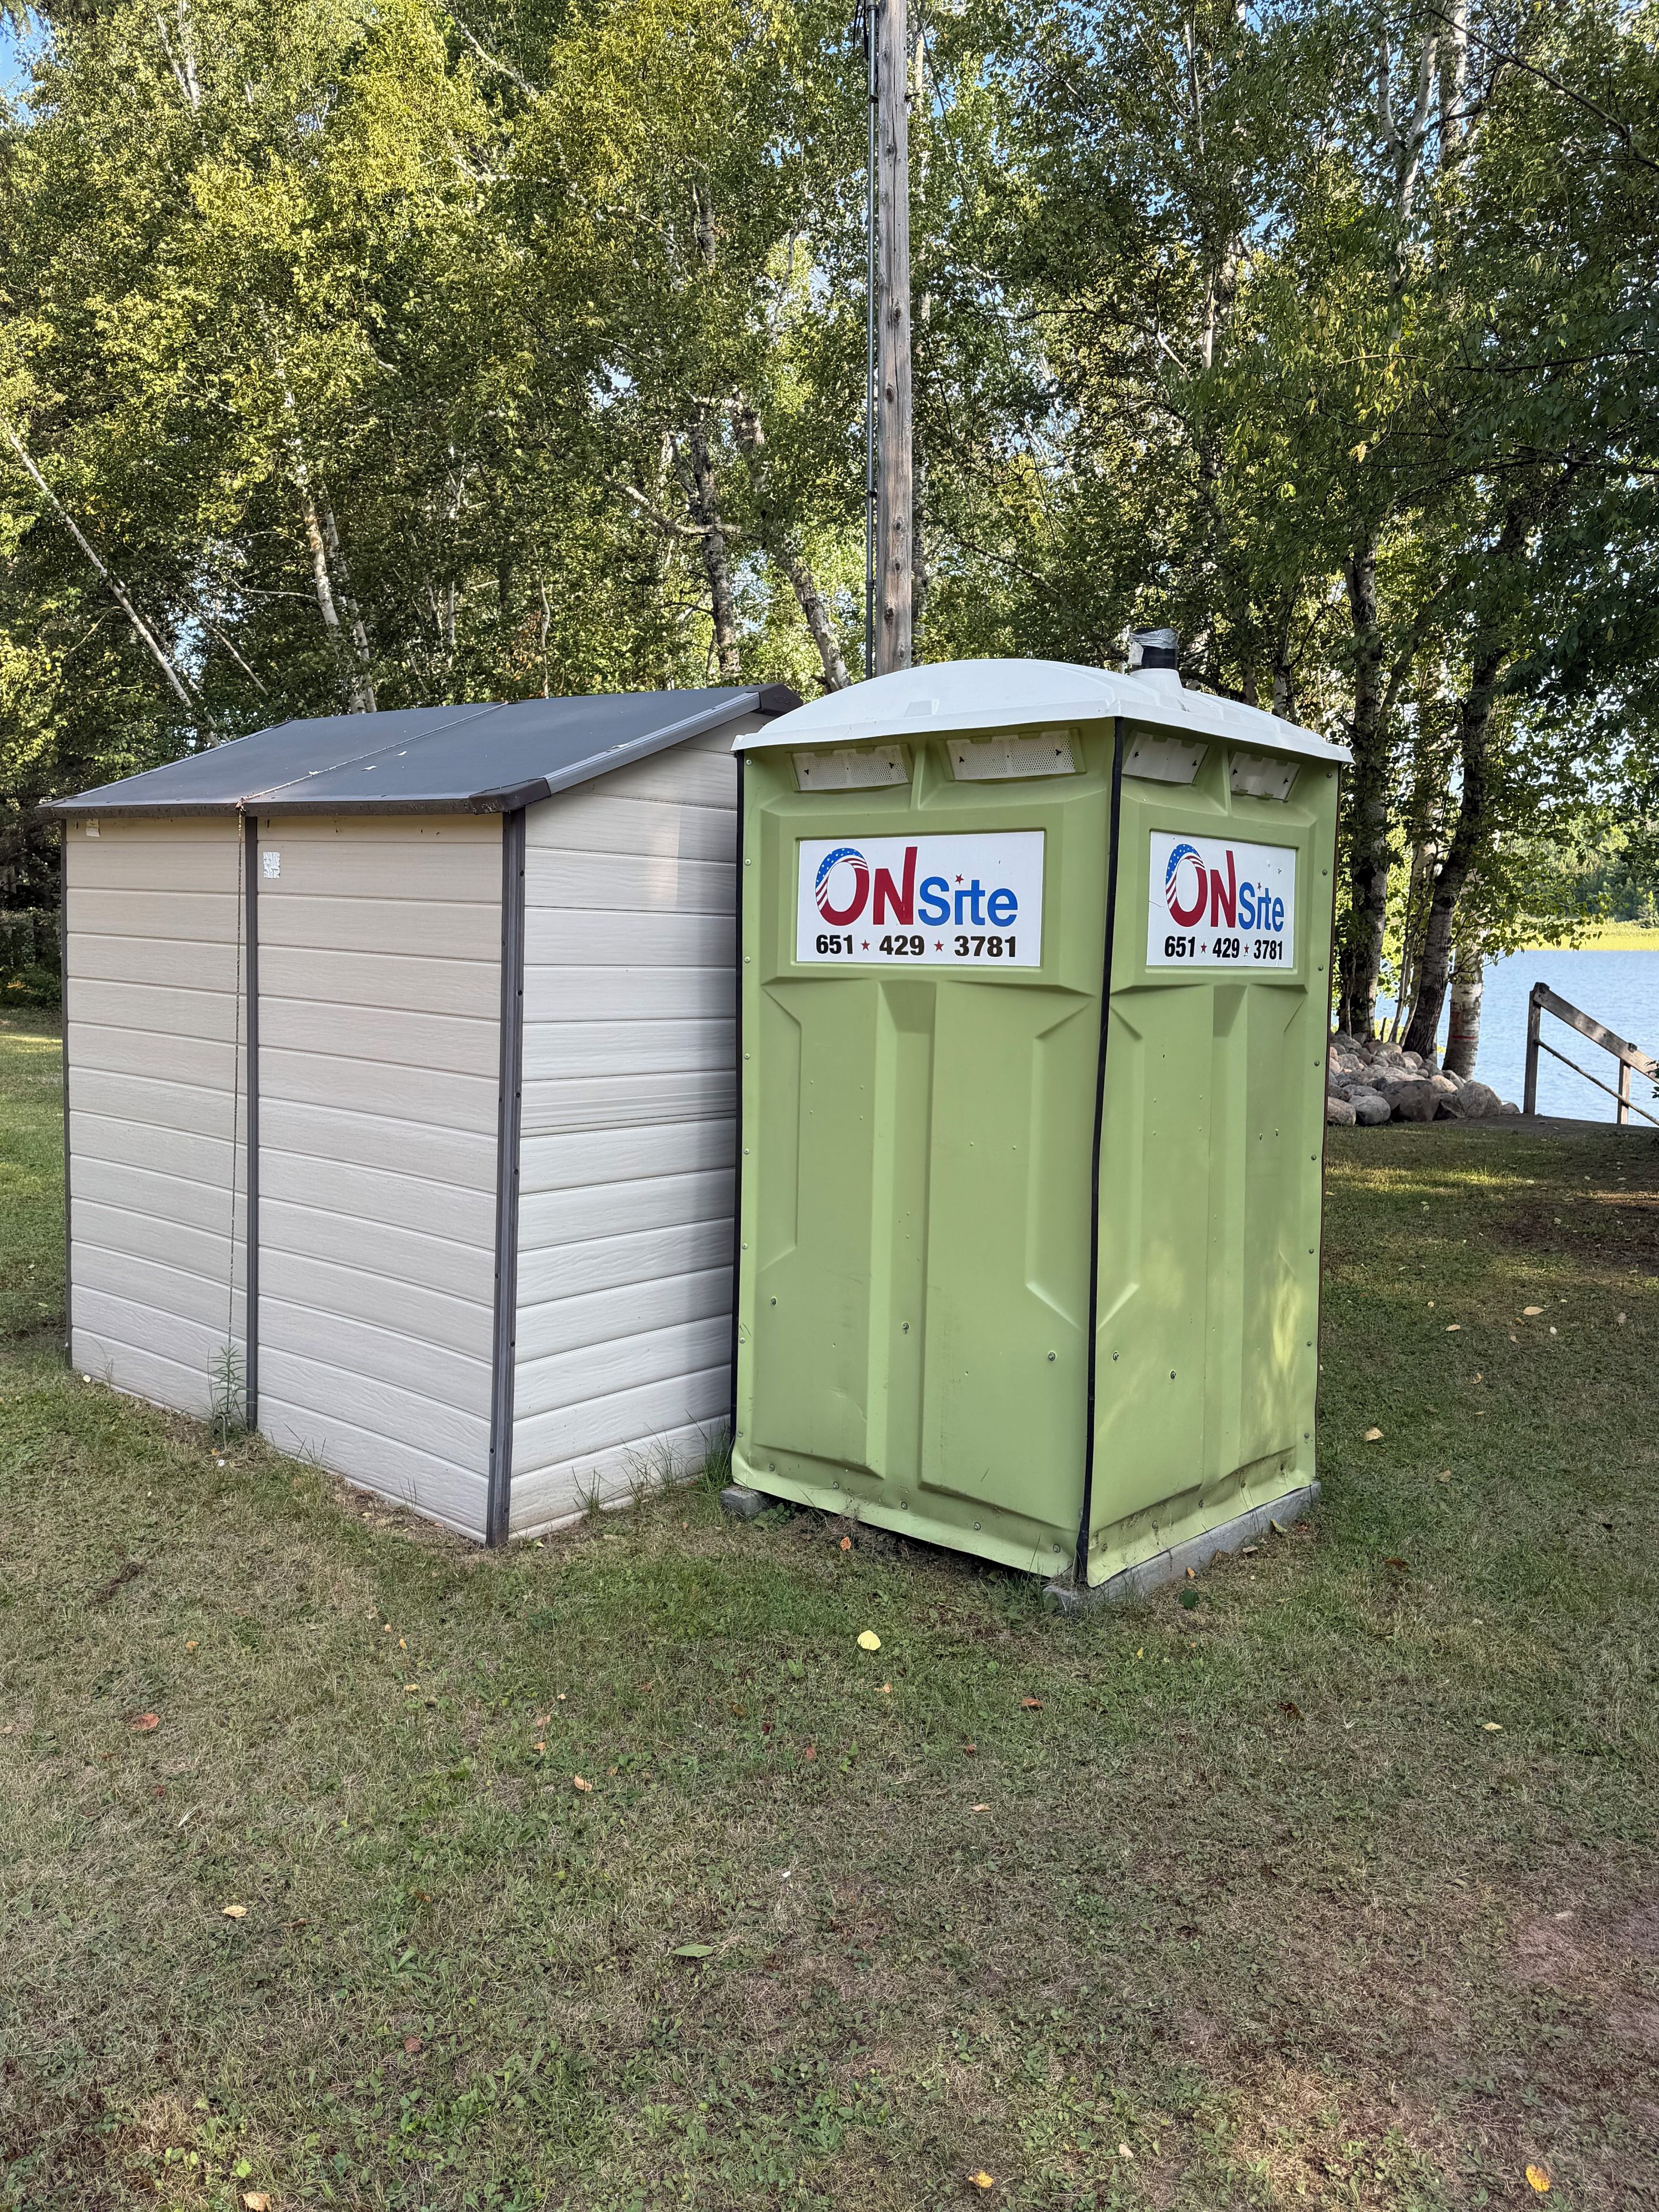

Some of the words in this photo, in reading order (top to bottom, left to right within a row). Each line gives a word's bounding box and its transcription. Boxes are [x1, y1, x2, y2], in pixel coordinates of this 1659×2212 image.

[816, 934, 853, 955] 651
[878, 935, 925, 956] 429
[954, 935, 1016, 957] 3781
[1164, 935, 1196, 957] 651
[1212, 937, 1240, 959] 429
[1253, 939, 1283, 960] 3781
